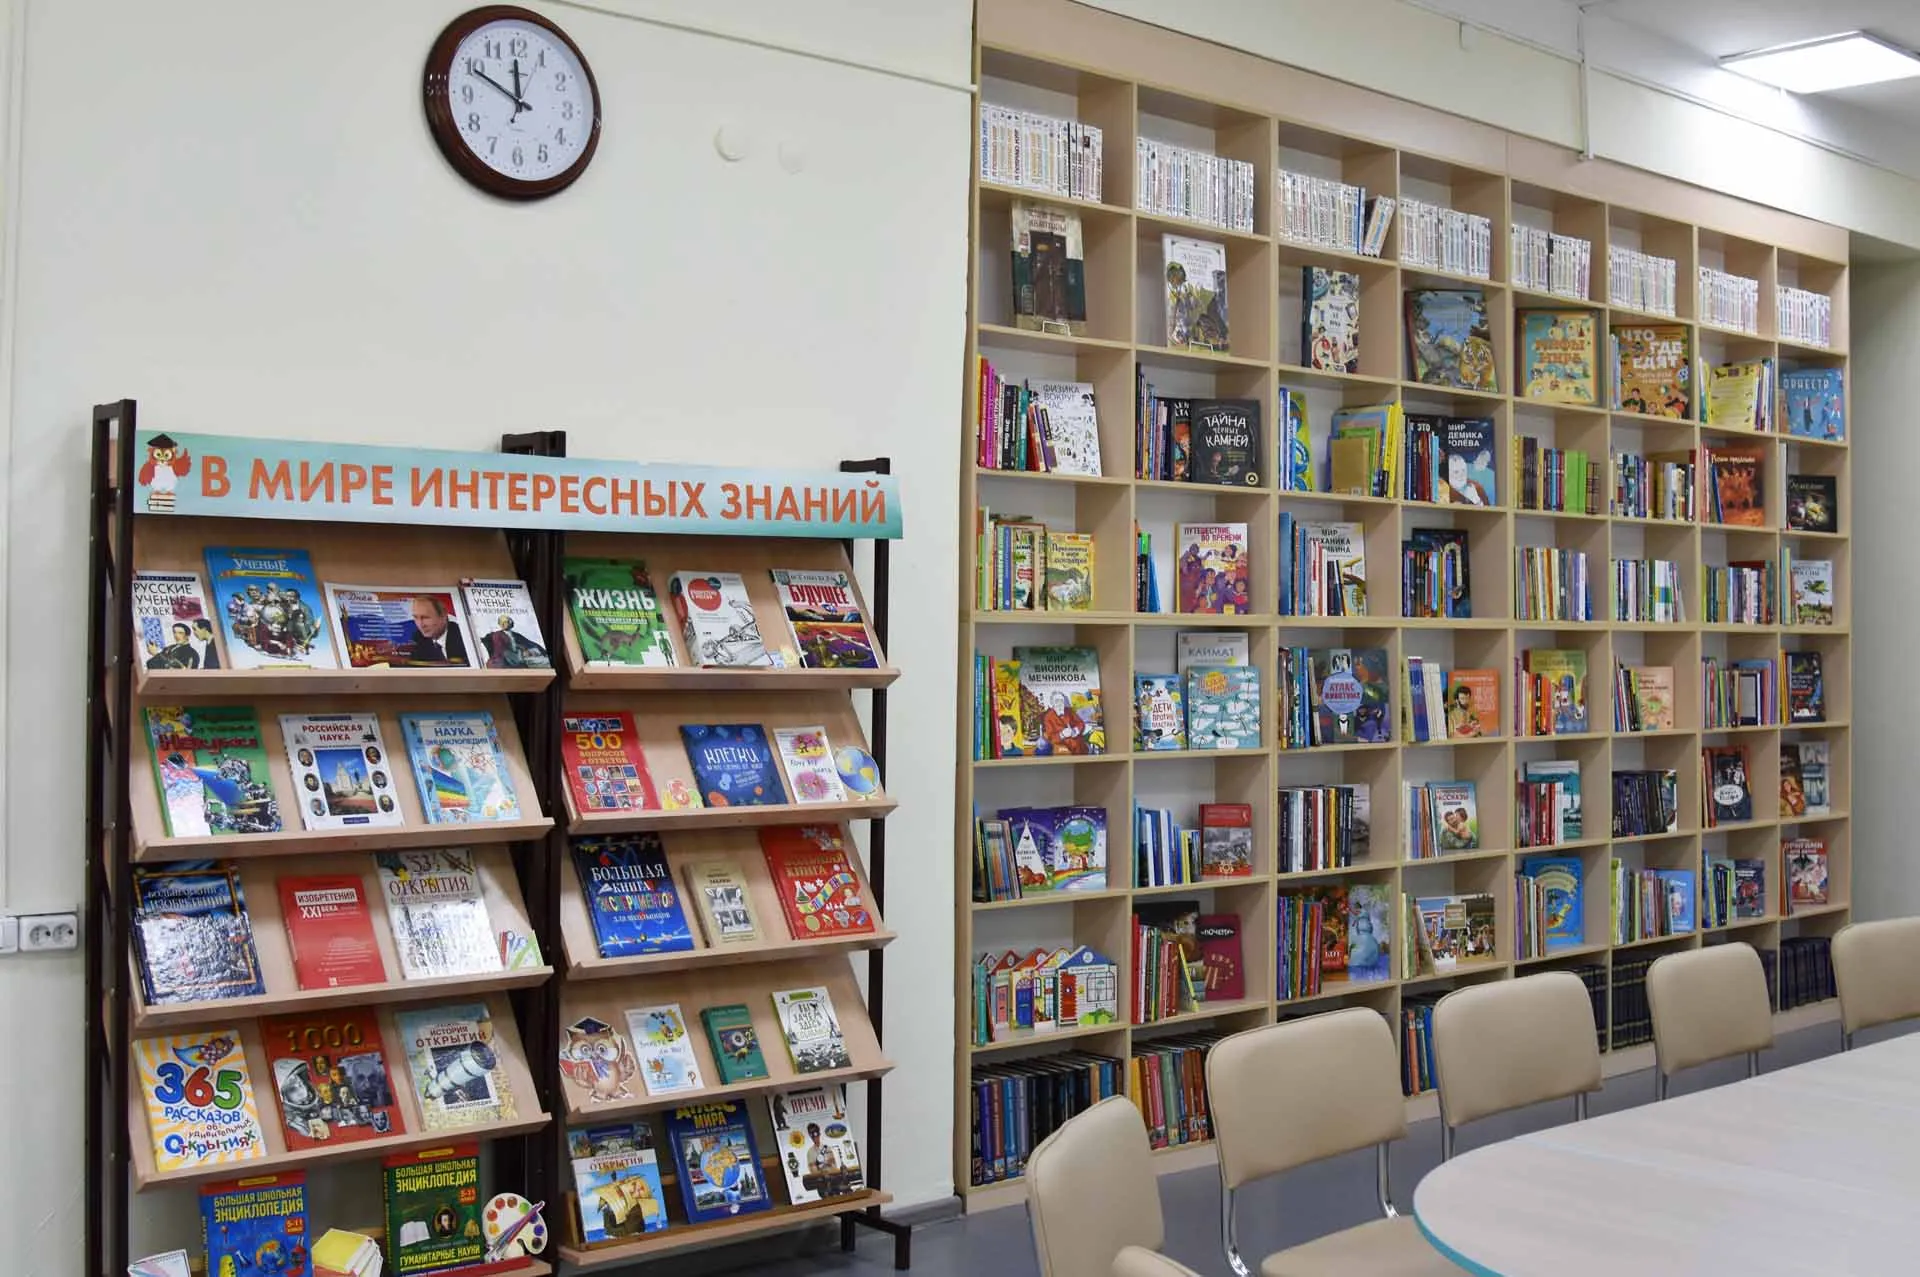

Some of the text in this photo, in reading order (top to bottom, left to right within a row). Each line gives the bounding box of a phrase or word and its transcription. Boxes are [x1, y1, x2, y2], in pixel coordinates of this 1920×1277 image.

[485, 40, 502, 60] 11
[509, 38, 528, 58] 12
[465, 57, 485, 76] 10
[538, 49, 546, 68] 1
[555, 71, 566, 92] 2
[462, 85, 474, 105] 9
[562, 101, 573, 120] 3
[468, 113, 480, 132] 8
[487, 136, 498, 154] 7
[554, 127, 566, 145] 4
[512, 147, 523, 167] 6
[538, 144, 548, 163] 5
[1043, 384, 1080, 393] ФИЗИКА
[1203, 412, 1247, 428] ТАЙНА
[1448, 423, 1466, 431] МИР
[1205, 434, 1249, 448] КАМНЕЙ
[202, 455, 886, 524] В МИРЕ ИНТЕРЕСНЫХ ЗНАНИЙ
[232, 558, 289, 571] УЧЕНЫЕ
[133, 582, 193, 595] РУССКИЕ
[471, 588, 513, 599] РУССКИЕ
[789, 584, 850, 608] БУДУЩЕЕ
[135, 594, 187, 606] УЧЕНЫЕ
[474, 598, 512, 608] УЧЕНЫЕ
[574, 588, 657, 611] ЖИЗНЬ
[153, 607, 177, 616] ВЕКА
[1028, 673, 1087, 682] МЕЧНИКОВА
[1034, 664, 1079, 673] БИОЛОГА
[1153, 702, 1172, 713] ДЕТИ
[302, 723, 363, 733] РОССИЙСКАЯ
[434, 727, 474, 737] НАУКА
[319, 733, 351, 742] НАУКА
[576, 733, 622, 750] 500
[704, 746, 760, 764] КЛЕТКИ
[590, 863, 666, 882] БОЛЬШАЯ
[389, 876, 470, 896] ОТКРЫТИЯ
[611, 881, 655, 894] КНИГА
[297, 890, 356, 904] ИЗОБРЕТЕНИЯ
[301, 905, 338, 920] XXI ВЕКА
[286, 1023, 363, 1052] 1000
[430, 1026, 468, 1037] ИСТОРИЯ
[155, 1062, 243, 1111] 365
[791, 1094, 828, 1114] ВРЕМЯ
[164, 1106, 241, 1125] РАССКАЗОВ
[694, 1111, 728, 1129] МИРА
[188, 1118, 251, 1139] удивительных
[164, 1129, 256, 1157] Открытиях
[395, 1158, 476, 1178] БОЛЬШАЯ ШКОЛЬНАЯ
[590, 1157, 644, 1171] ОТКРЫТИЯ
[396, 1170, 477, 1193] ЭНЦИКЛОПЕДИЯ
[214, 1187, 303, 1208] БОЛЬШАЯ ШКОЛЬНАЯ
[215, 1199, 304, 1224] ЭНЦИКЛОПЕДИЯ
[400, 1245, 481, 1266] ГУМАНИТАРНЫЕ НАУКИ
